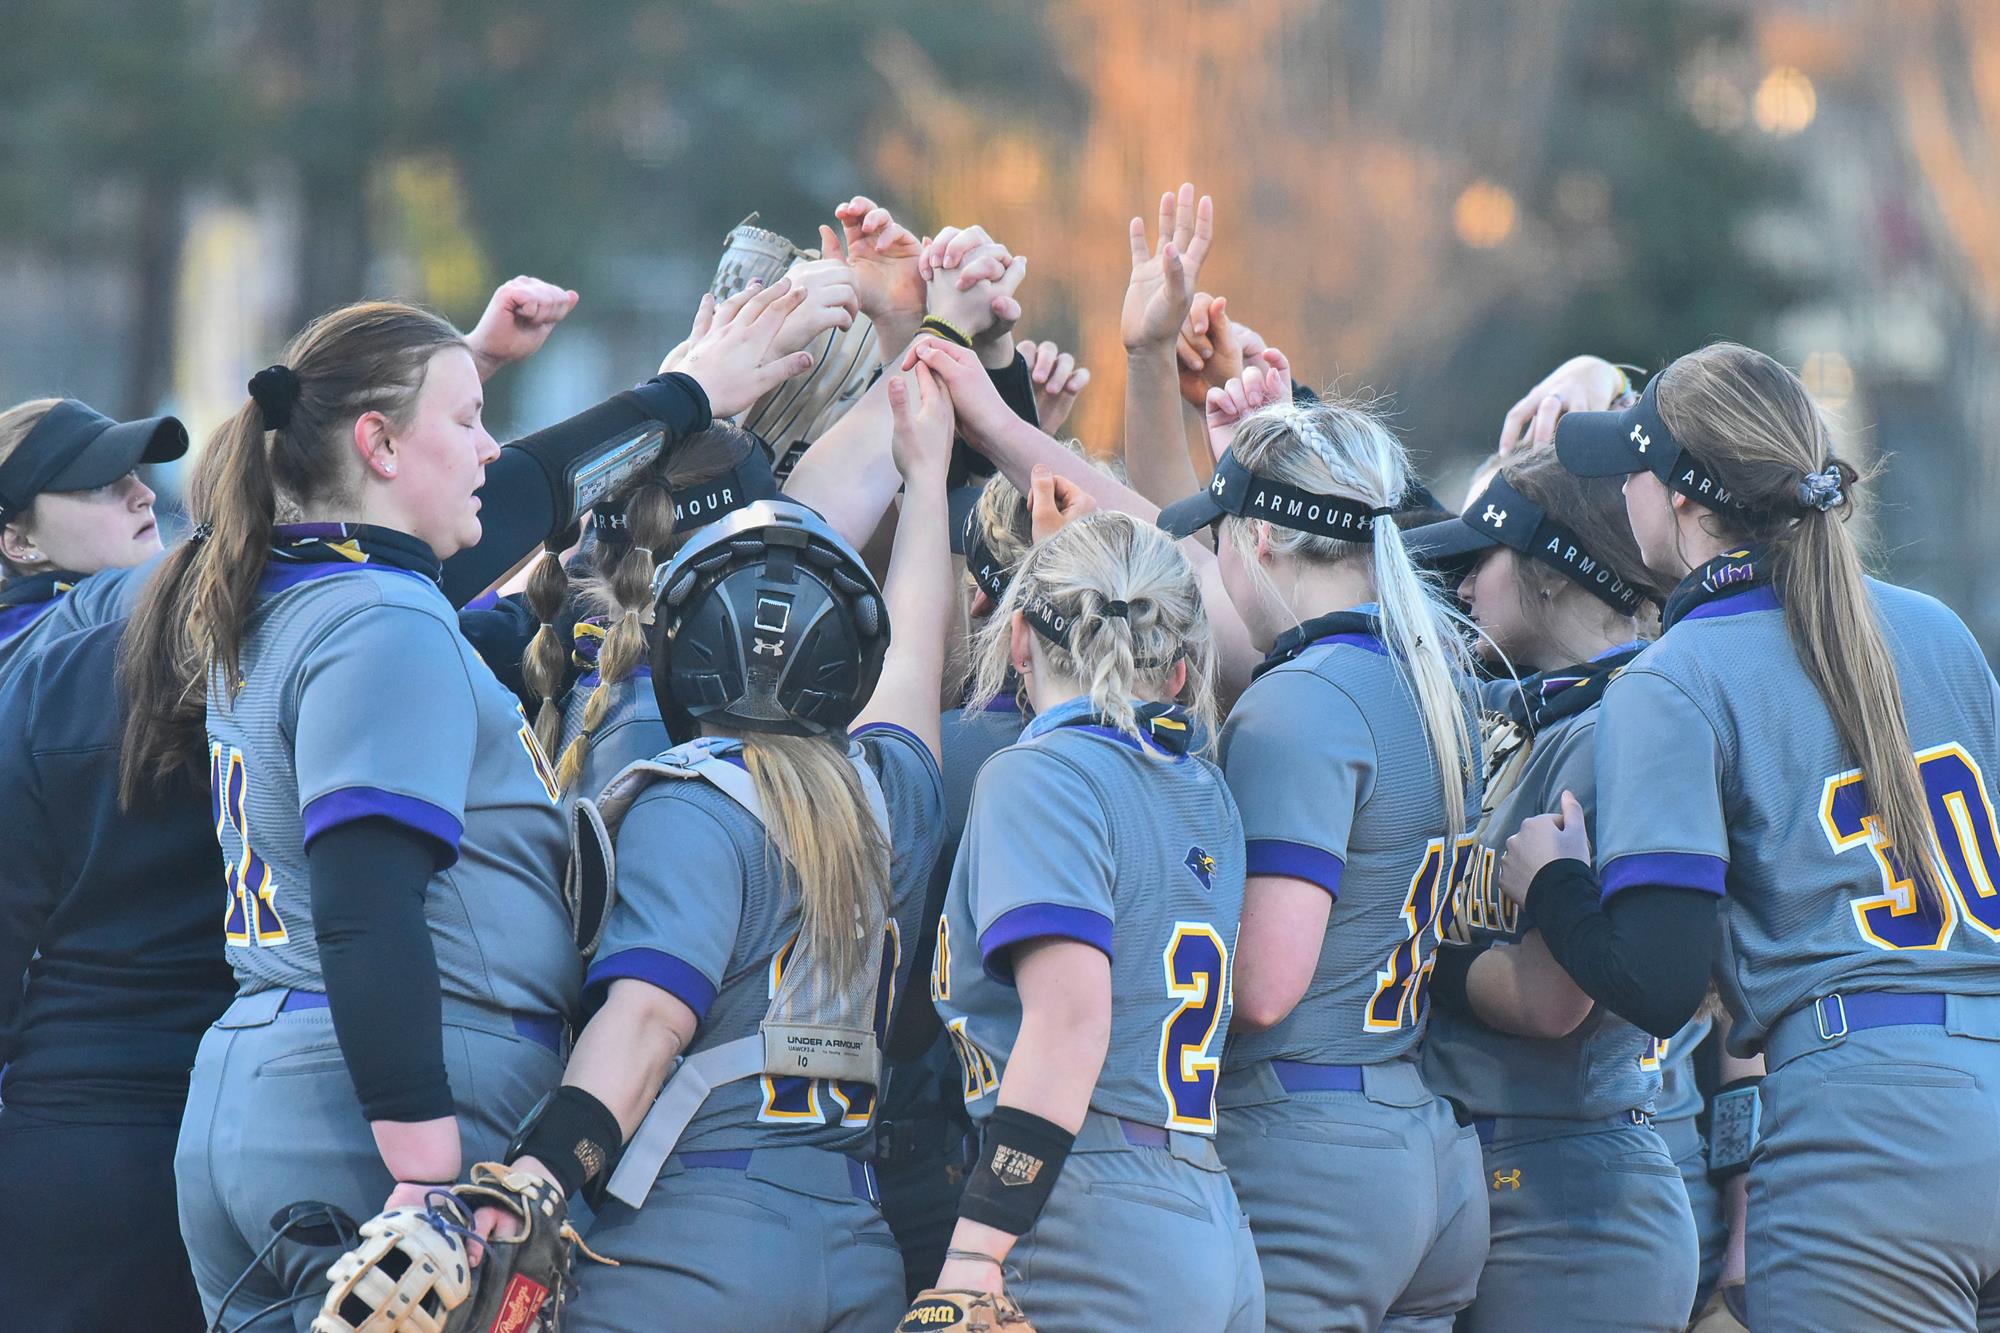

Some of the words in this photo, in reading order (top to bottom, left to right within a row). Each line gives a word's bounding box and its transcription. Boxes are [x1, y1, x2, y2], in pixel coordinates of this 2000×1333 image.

[1254, 490, 1353, 529] ARMOUR
[1682, 469, 1745, 509] ARM
[1546, 537, 1634, 602] ARMOUR
[1817, 740, 2000, 951] 30
[787, 1036, 823, 1047] UNDER
[825, 1039, 861, 1051] ARMOUR
[1158, 921, 1240, 1134] 2
